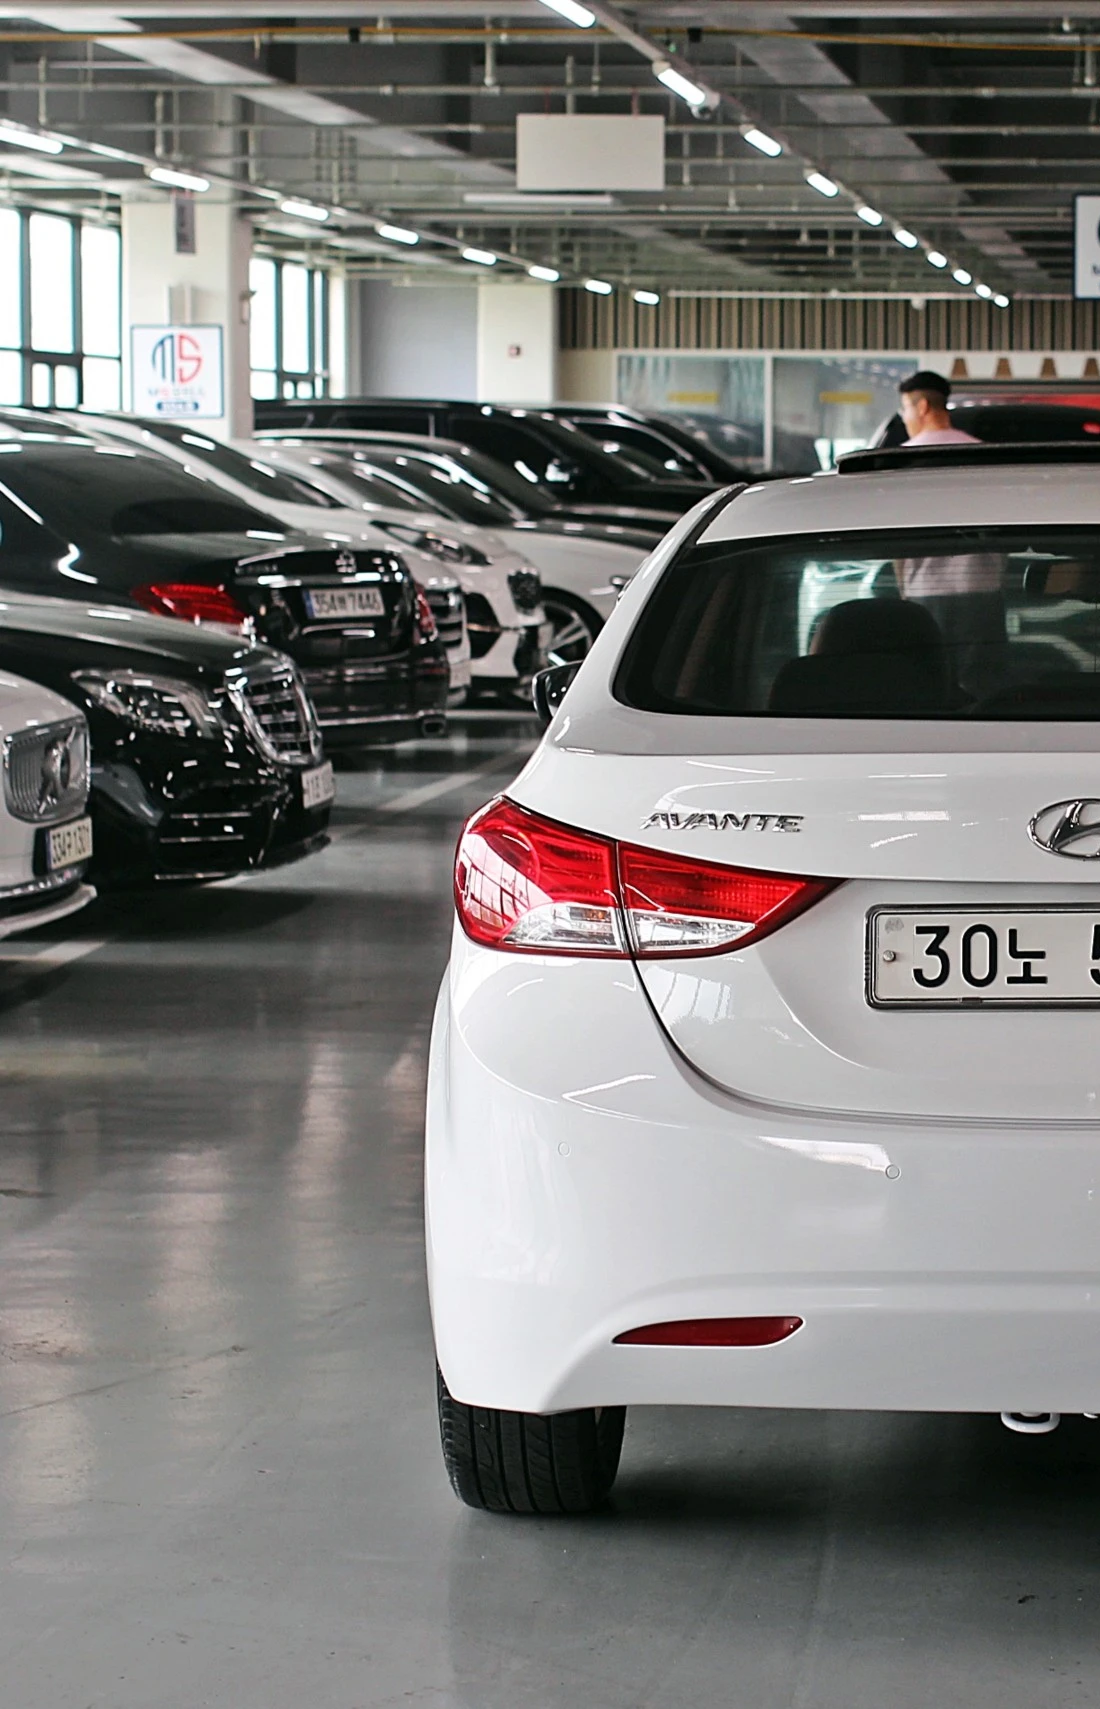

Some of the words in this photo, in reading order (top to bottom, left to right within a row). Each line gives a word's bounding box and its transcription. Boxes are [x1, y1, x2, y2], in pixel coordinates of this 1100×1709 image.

[151, 334, 202, 384] MS
[640, 812, 804, 833] AVANTE
[912, 924, 1048, 988] 30노
